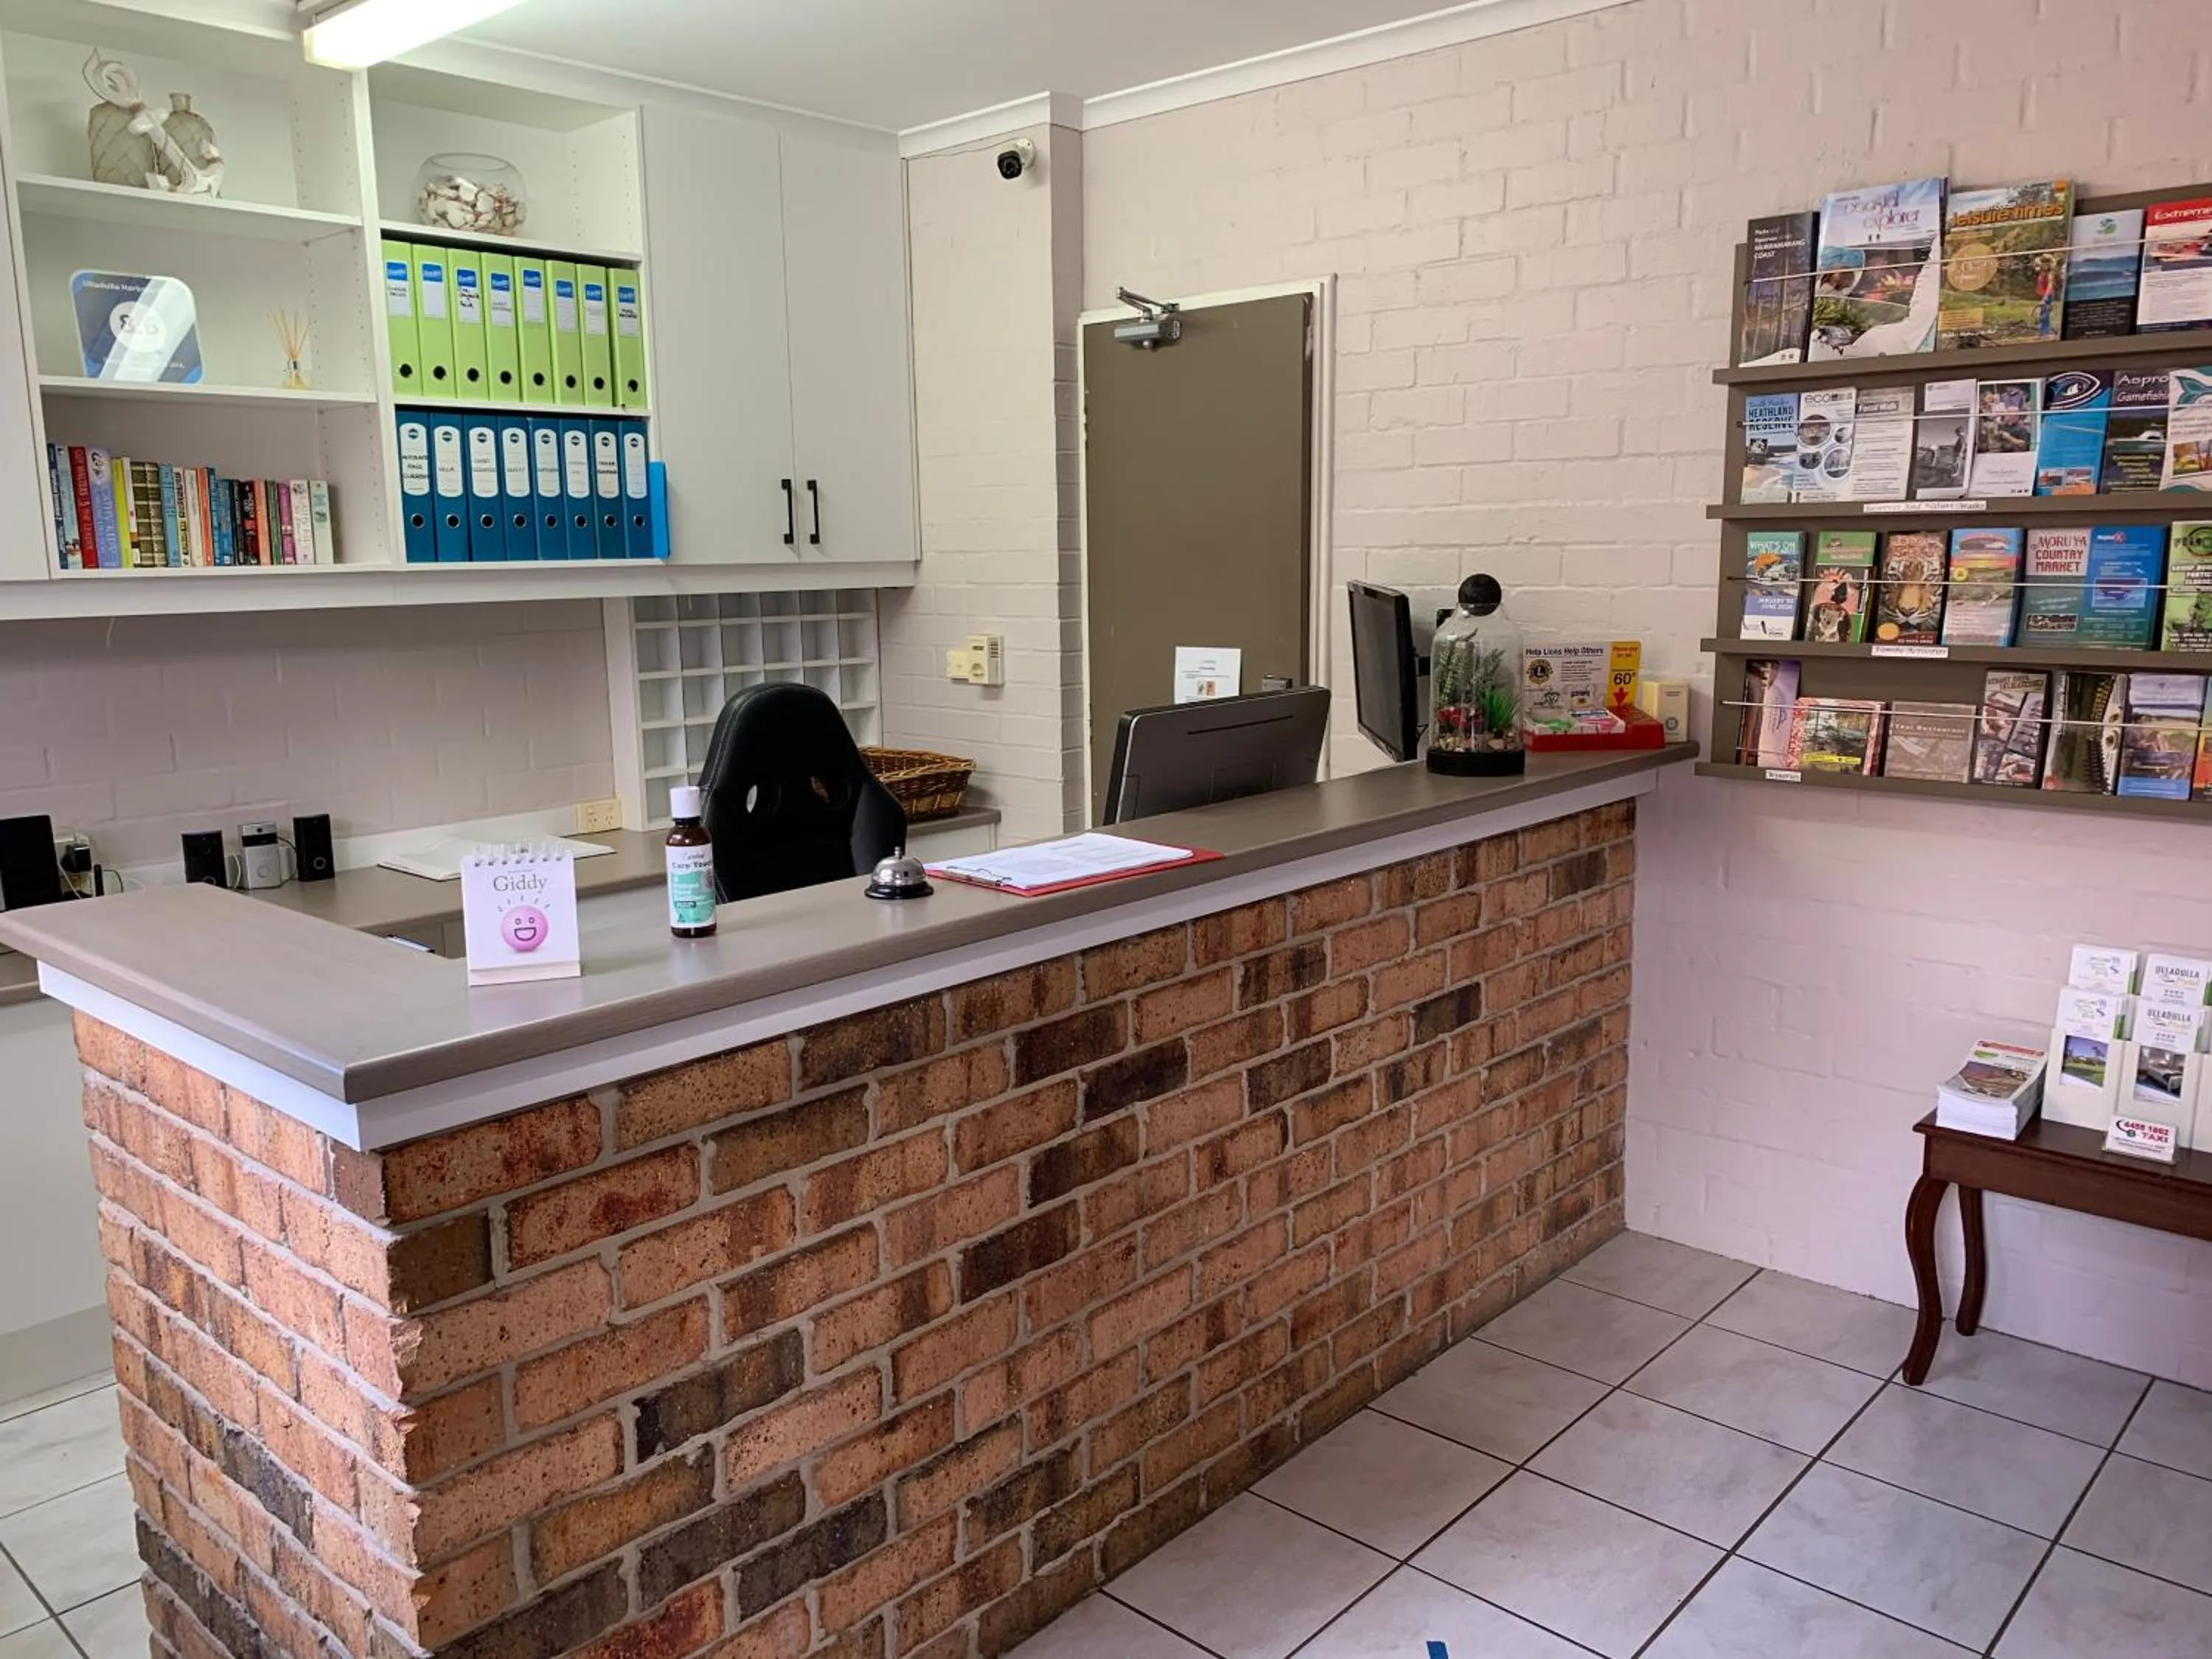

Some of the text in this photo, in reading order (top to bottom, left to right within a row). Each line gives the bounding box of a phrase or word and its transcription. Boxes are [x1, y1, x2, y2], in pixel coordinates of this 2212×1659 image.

[2012, 204, 2065, 220] times
[1804, 394, 1831, 403] eco
[1747, 405, 1793, 417] HEATHLAND
[1748, 416, 1794, 431] RESERVE
[2037, 536, 2087, 548] MORUYA
[2035, 550, 2084, 560] COUNTRY
[2035, 562, 2081, 572] MARKET
[1526, 647, 1542, 655] Help
[1543, 647, 1562, 655] Lions
[1564, 647, 1580, 655] Help
[1581, 647, 1604, 655] Others
[493, 874, 548, 894] Giddy
[2155, 966, 2199, 978] ULLADULLA
[2147, 1008, 2191, 1021] ULLADULLA
[2142, 1133, 2168, 1143] TAXI
